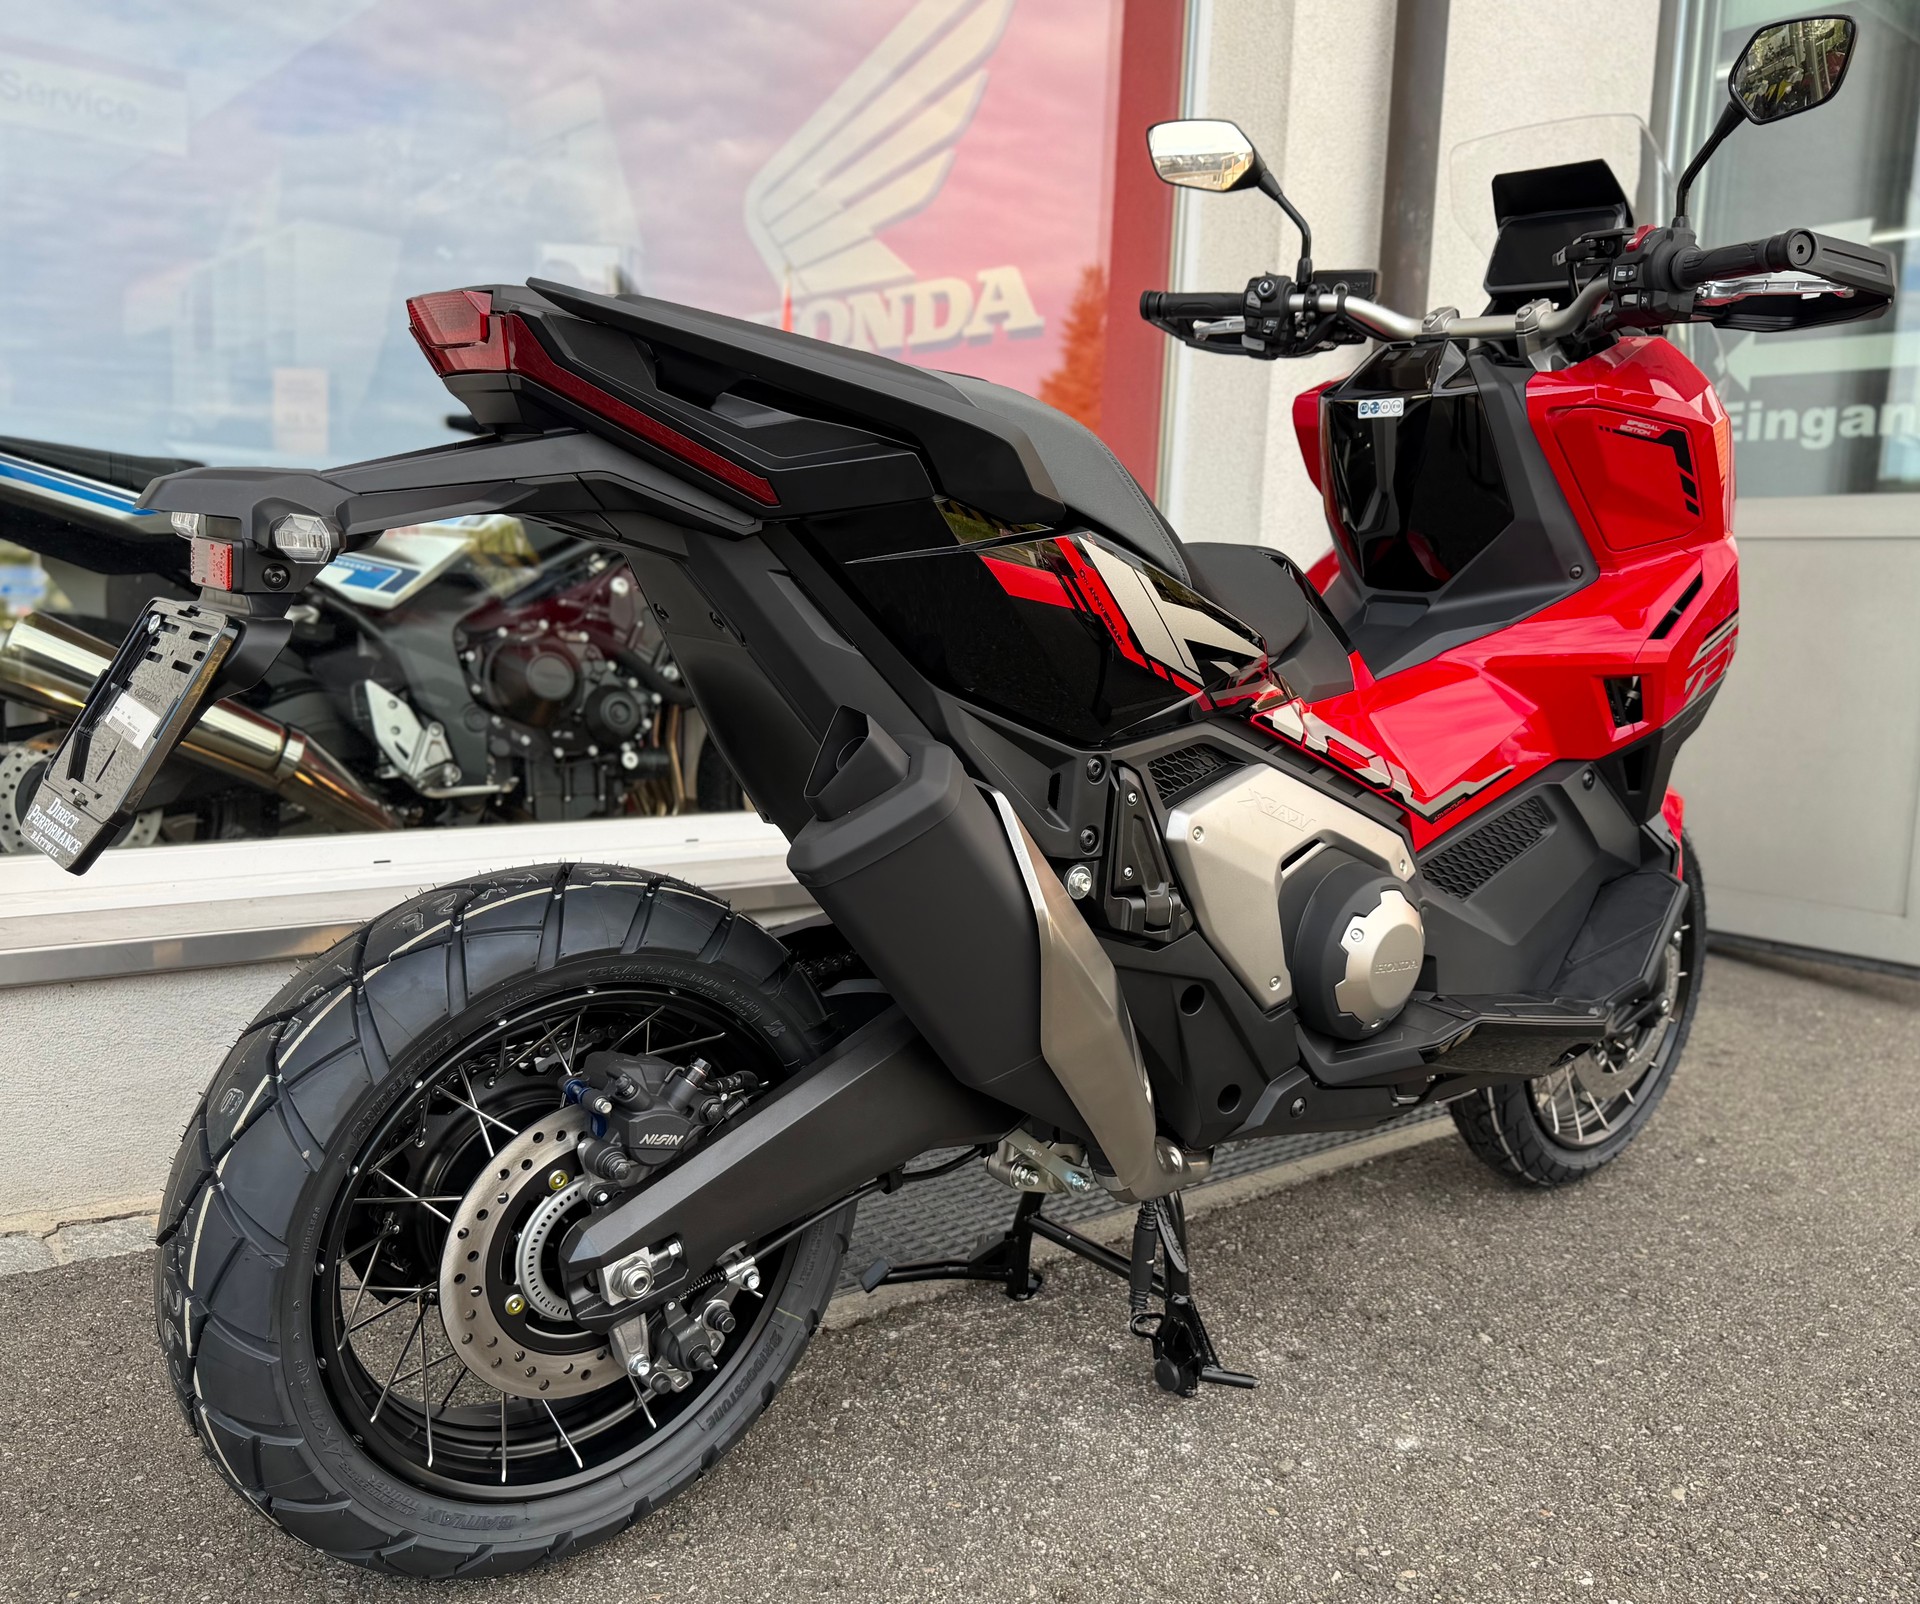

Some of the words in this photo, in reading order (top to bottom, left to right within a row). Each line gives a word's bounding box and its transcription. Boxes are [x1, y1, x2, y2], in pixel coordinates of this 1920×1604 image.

[0, 68, 139, 125] Service
[1620, 425, 1651, 436] EDITION
[1627, 420, 1660, 432] SPECIAL
[27, 804, 83, 855] PERFORMANCE
[46, 797, 80, 830] DIRECT
[1375, 959, 1419, 975] HONDA
[352, 1031, 454, 1140] BRIDGESTONE
[705, 1329, 783, 1431] BRIDGESTONE
